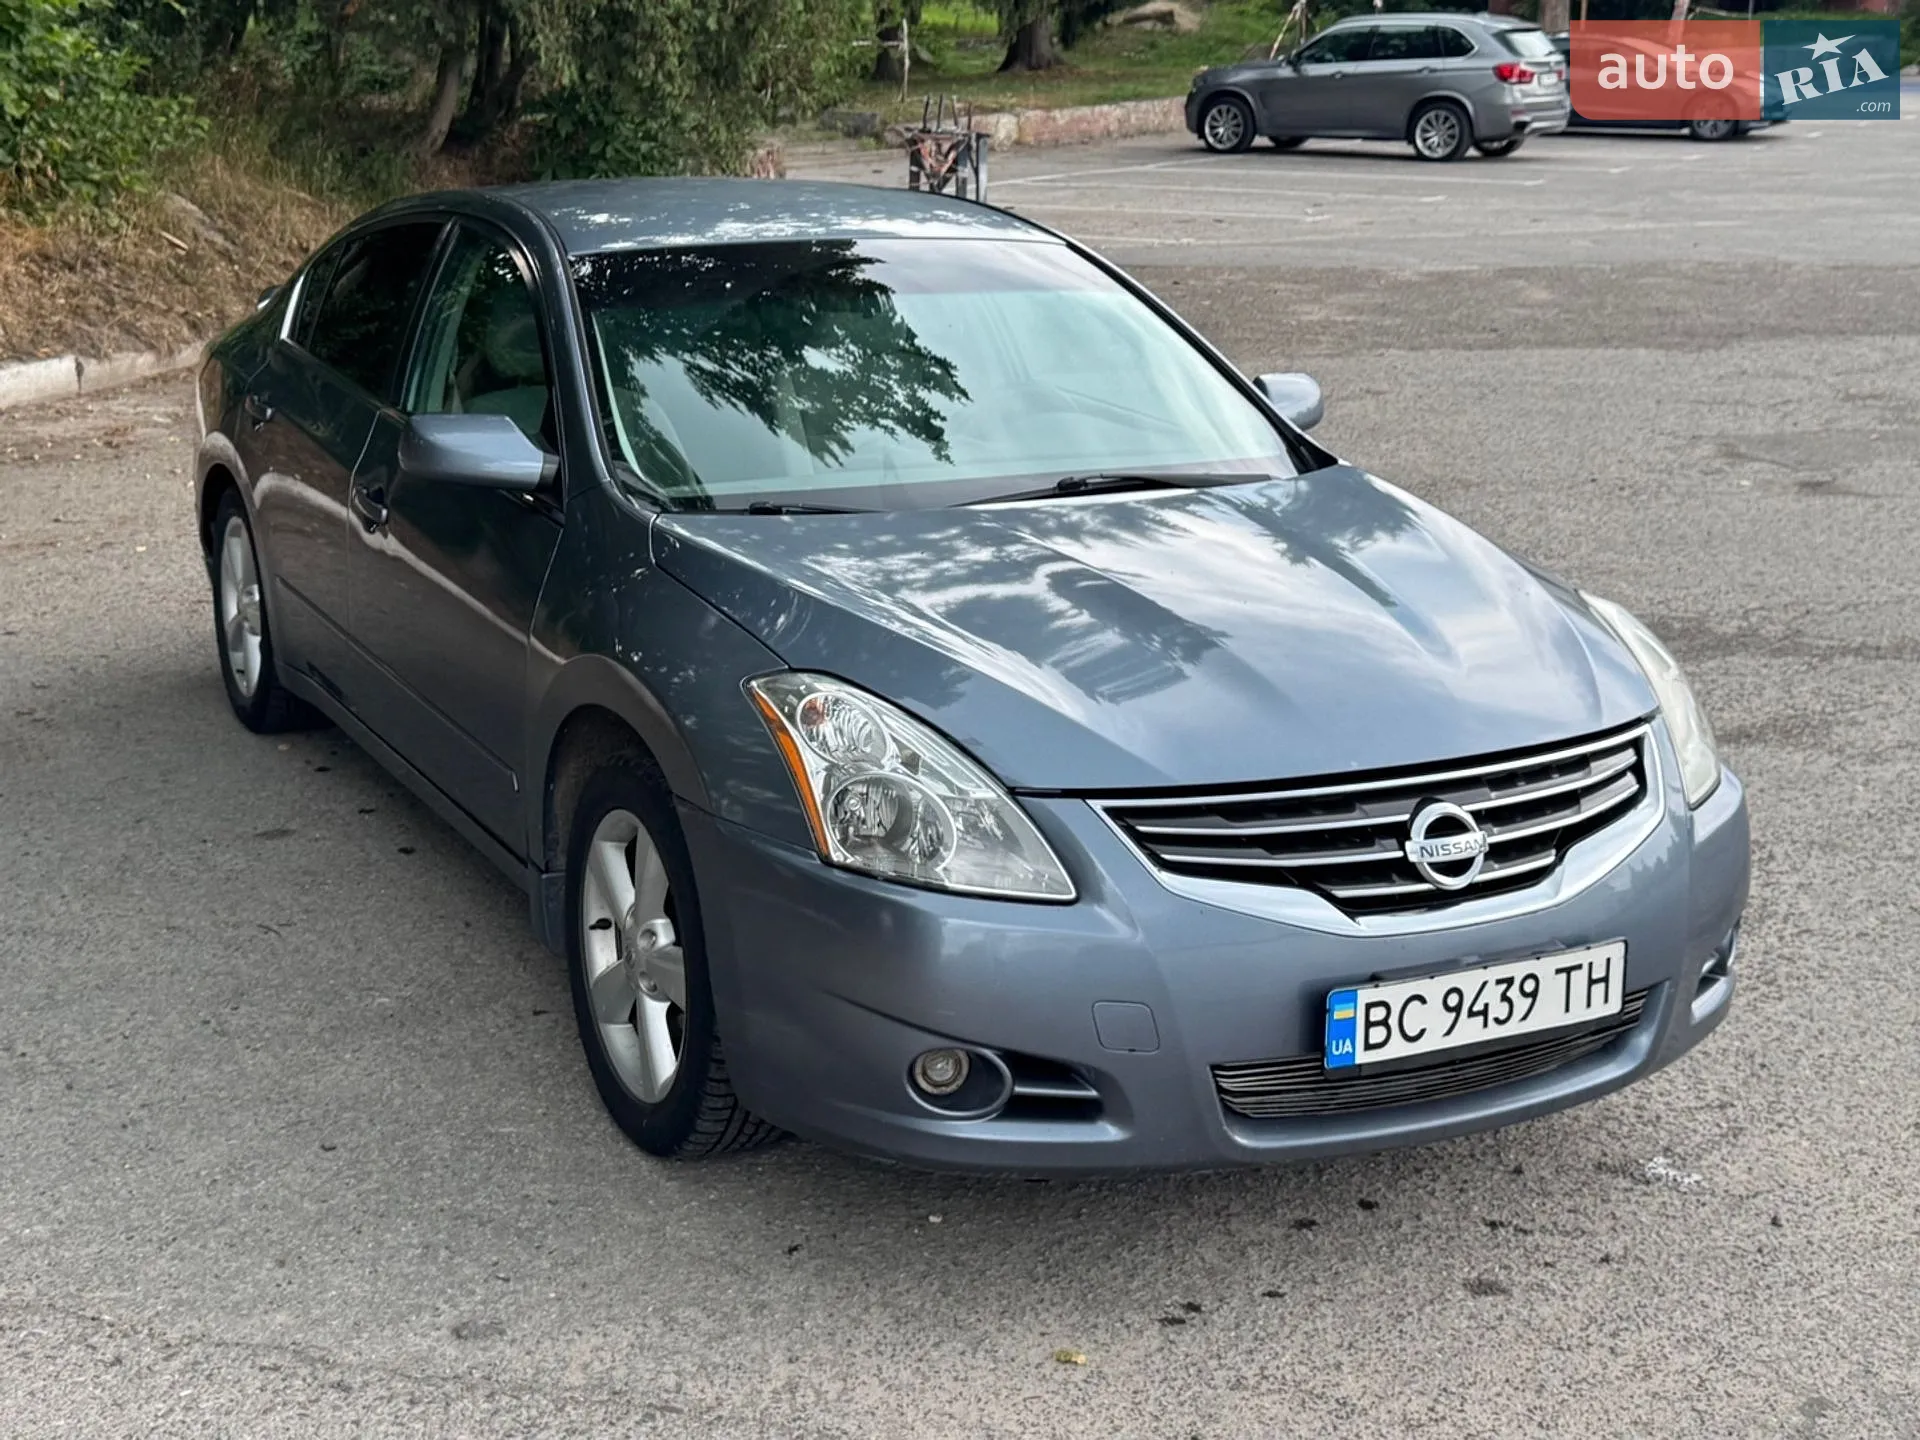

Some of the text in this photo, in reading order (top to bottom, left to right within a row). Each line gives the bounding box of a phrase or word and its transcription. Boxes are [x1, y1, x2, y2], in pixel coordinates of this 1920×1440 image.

[1420, 835, 1486, 858] NISSAN
[1363, 957, 1611, 1052] BC 9439 TH
[1332, 1041, 1353, 1056] UA
